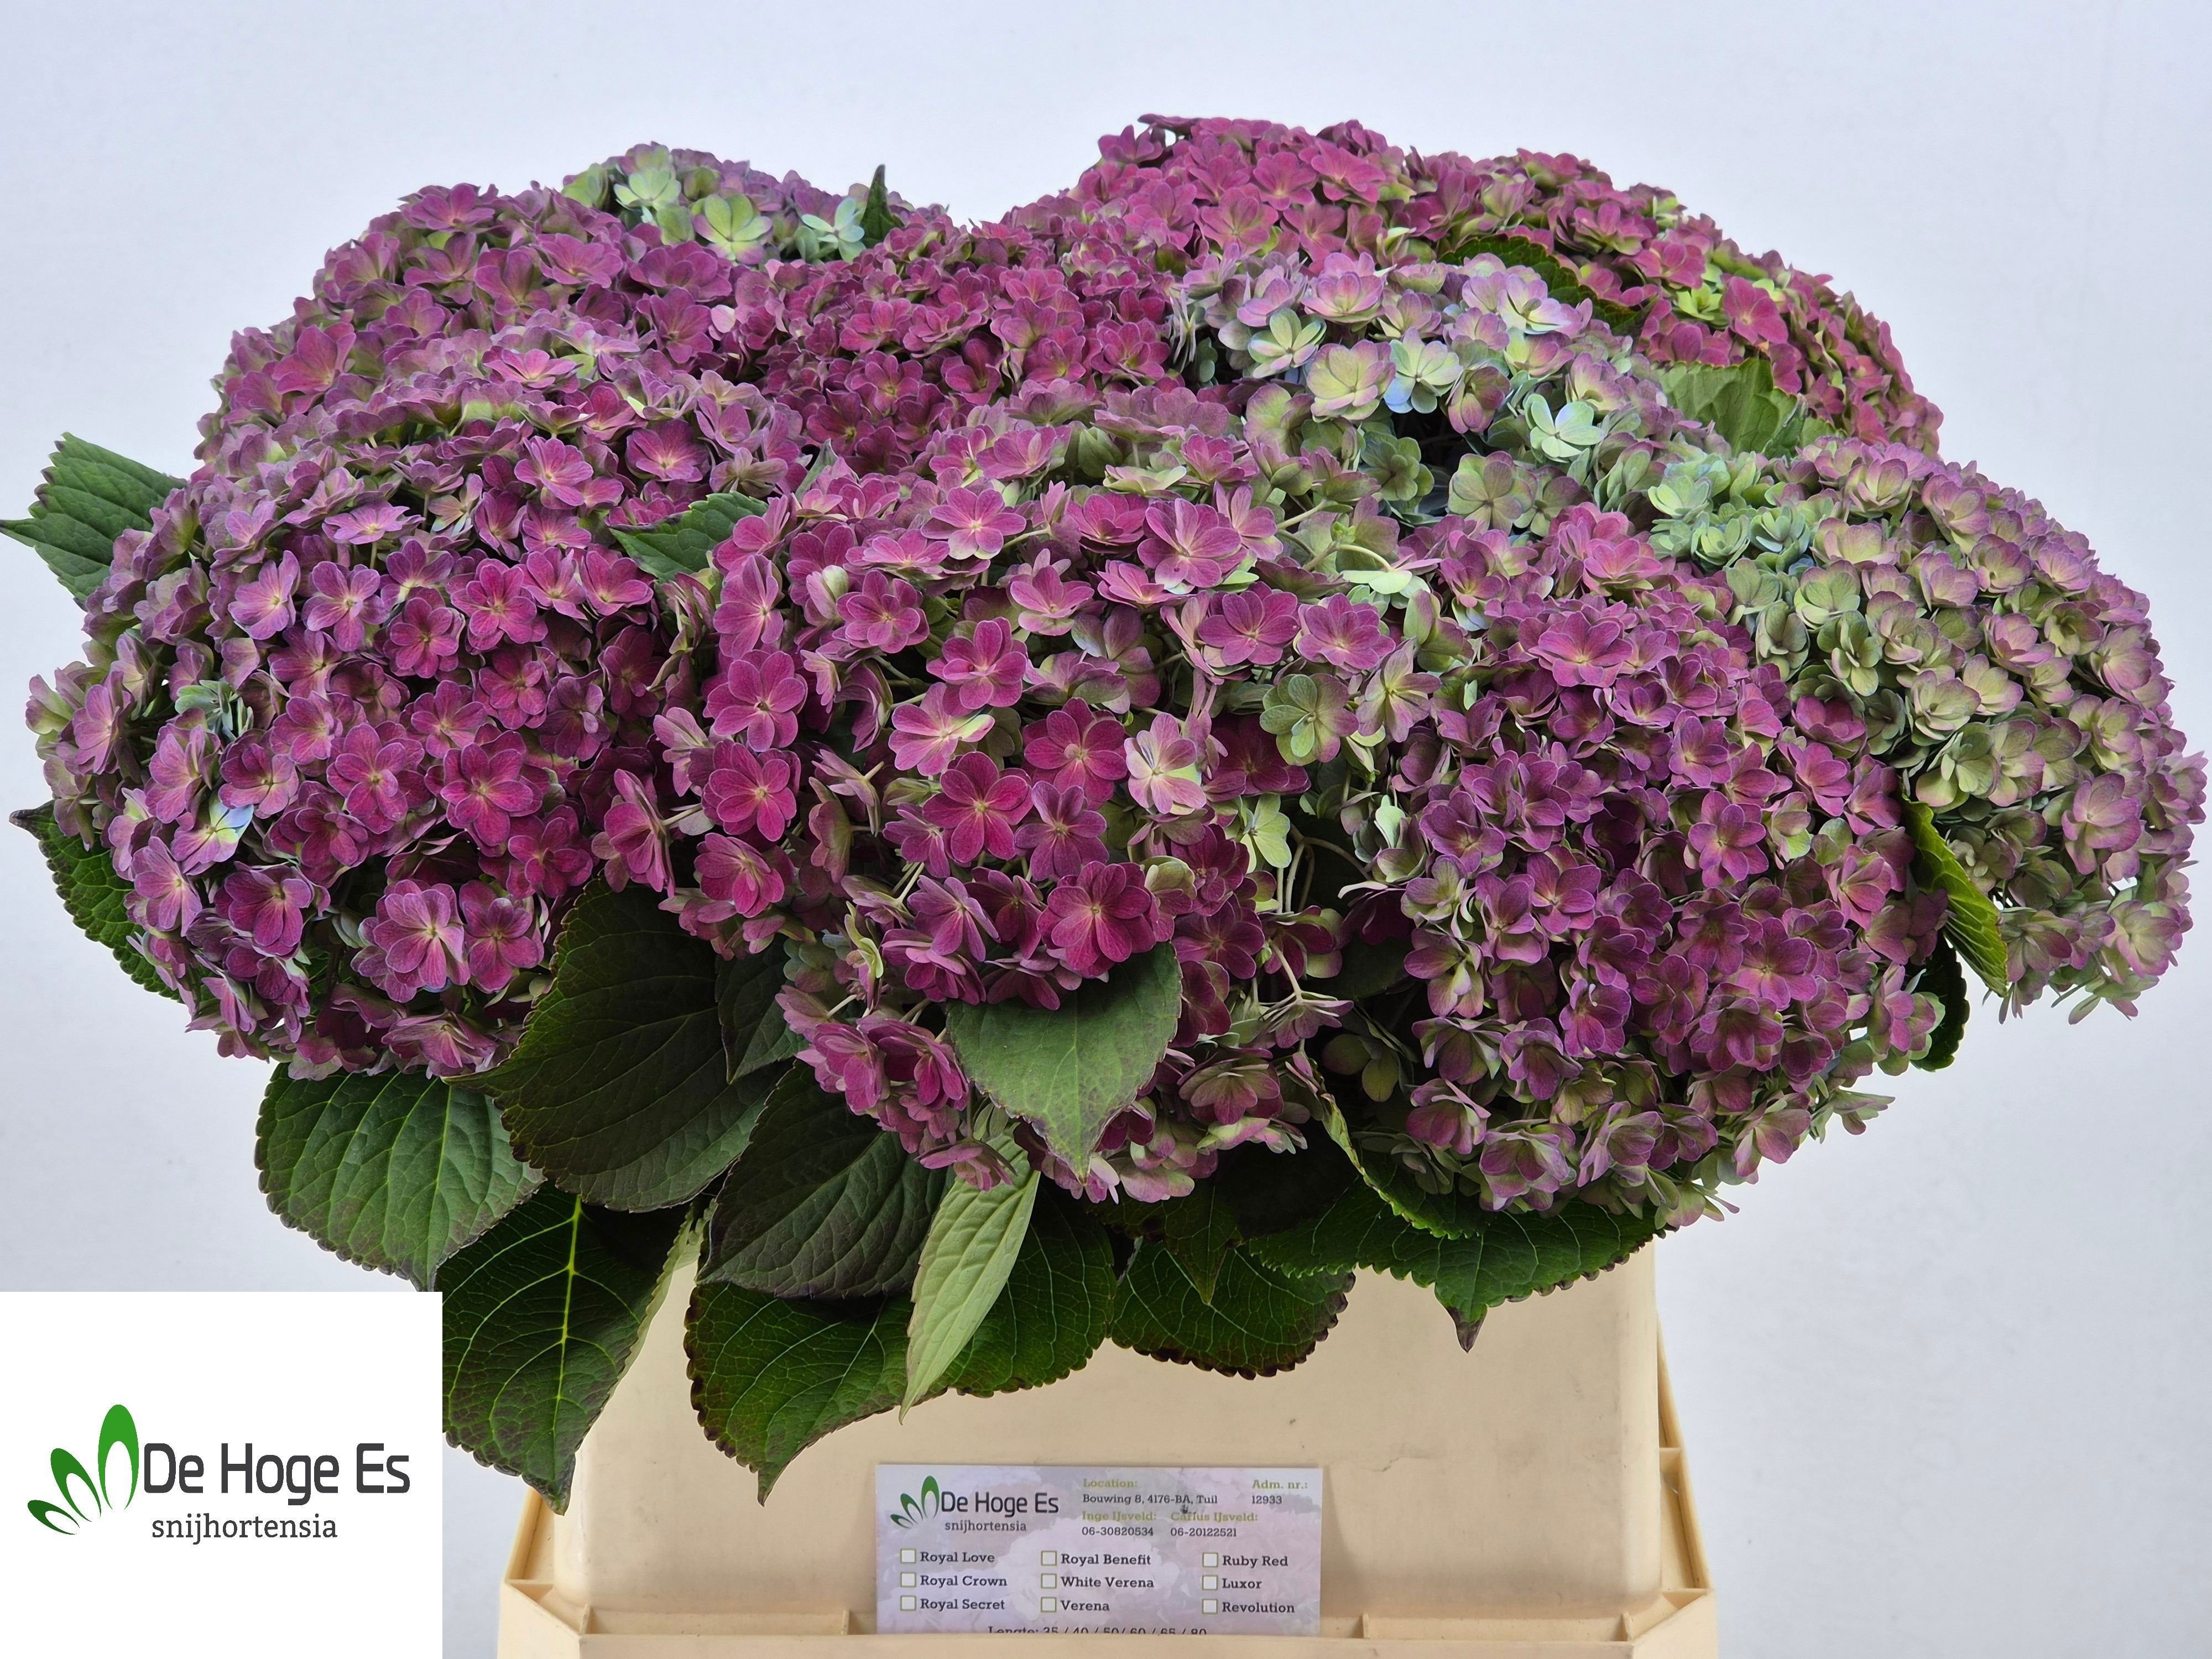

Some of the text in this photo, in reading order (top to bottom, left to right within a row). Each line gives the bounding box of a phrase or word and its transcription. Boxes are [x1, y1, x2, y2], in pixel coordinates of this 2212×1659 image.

[1083, 1478, 1138, 1489] Location:
[1252, 1480, 1308, 1489] Adm. nr.:
[941, 1491, 1059, 1518] De Hoge Es
[1082, 1494, 1218, 1505] Bouwing 8, 4176-BA, Tuil
[1251, 1495, 1282, 1505] 12933
[1082, 1511, 1109, 1522] Inge
[945, 1520, 1027, 1534] snijhortensia
[1082, 1527, 1154, 1536] 06-30820534
[1170, 1527, 1237, 1537] 06-20122521
[920, 1552, 995, 1564] Royal Love
[1061, 1554, 1151, 1566] Royal Benefit
[1222, 1555, 1288, 1568] Ruby Red
[920, 1575, 1008, 1588] Royal Crown
[1061, 1575, 1155, 1588] White Verena
[1222, 1578, 1262, 1589] Luxor
[920, 1598, 1005, 1611] Royal Secret
[1061, 1600, 1110, 1611] Verena
[1222, 1601, 1295, 1613] Revolution
